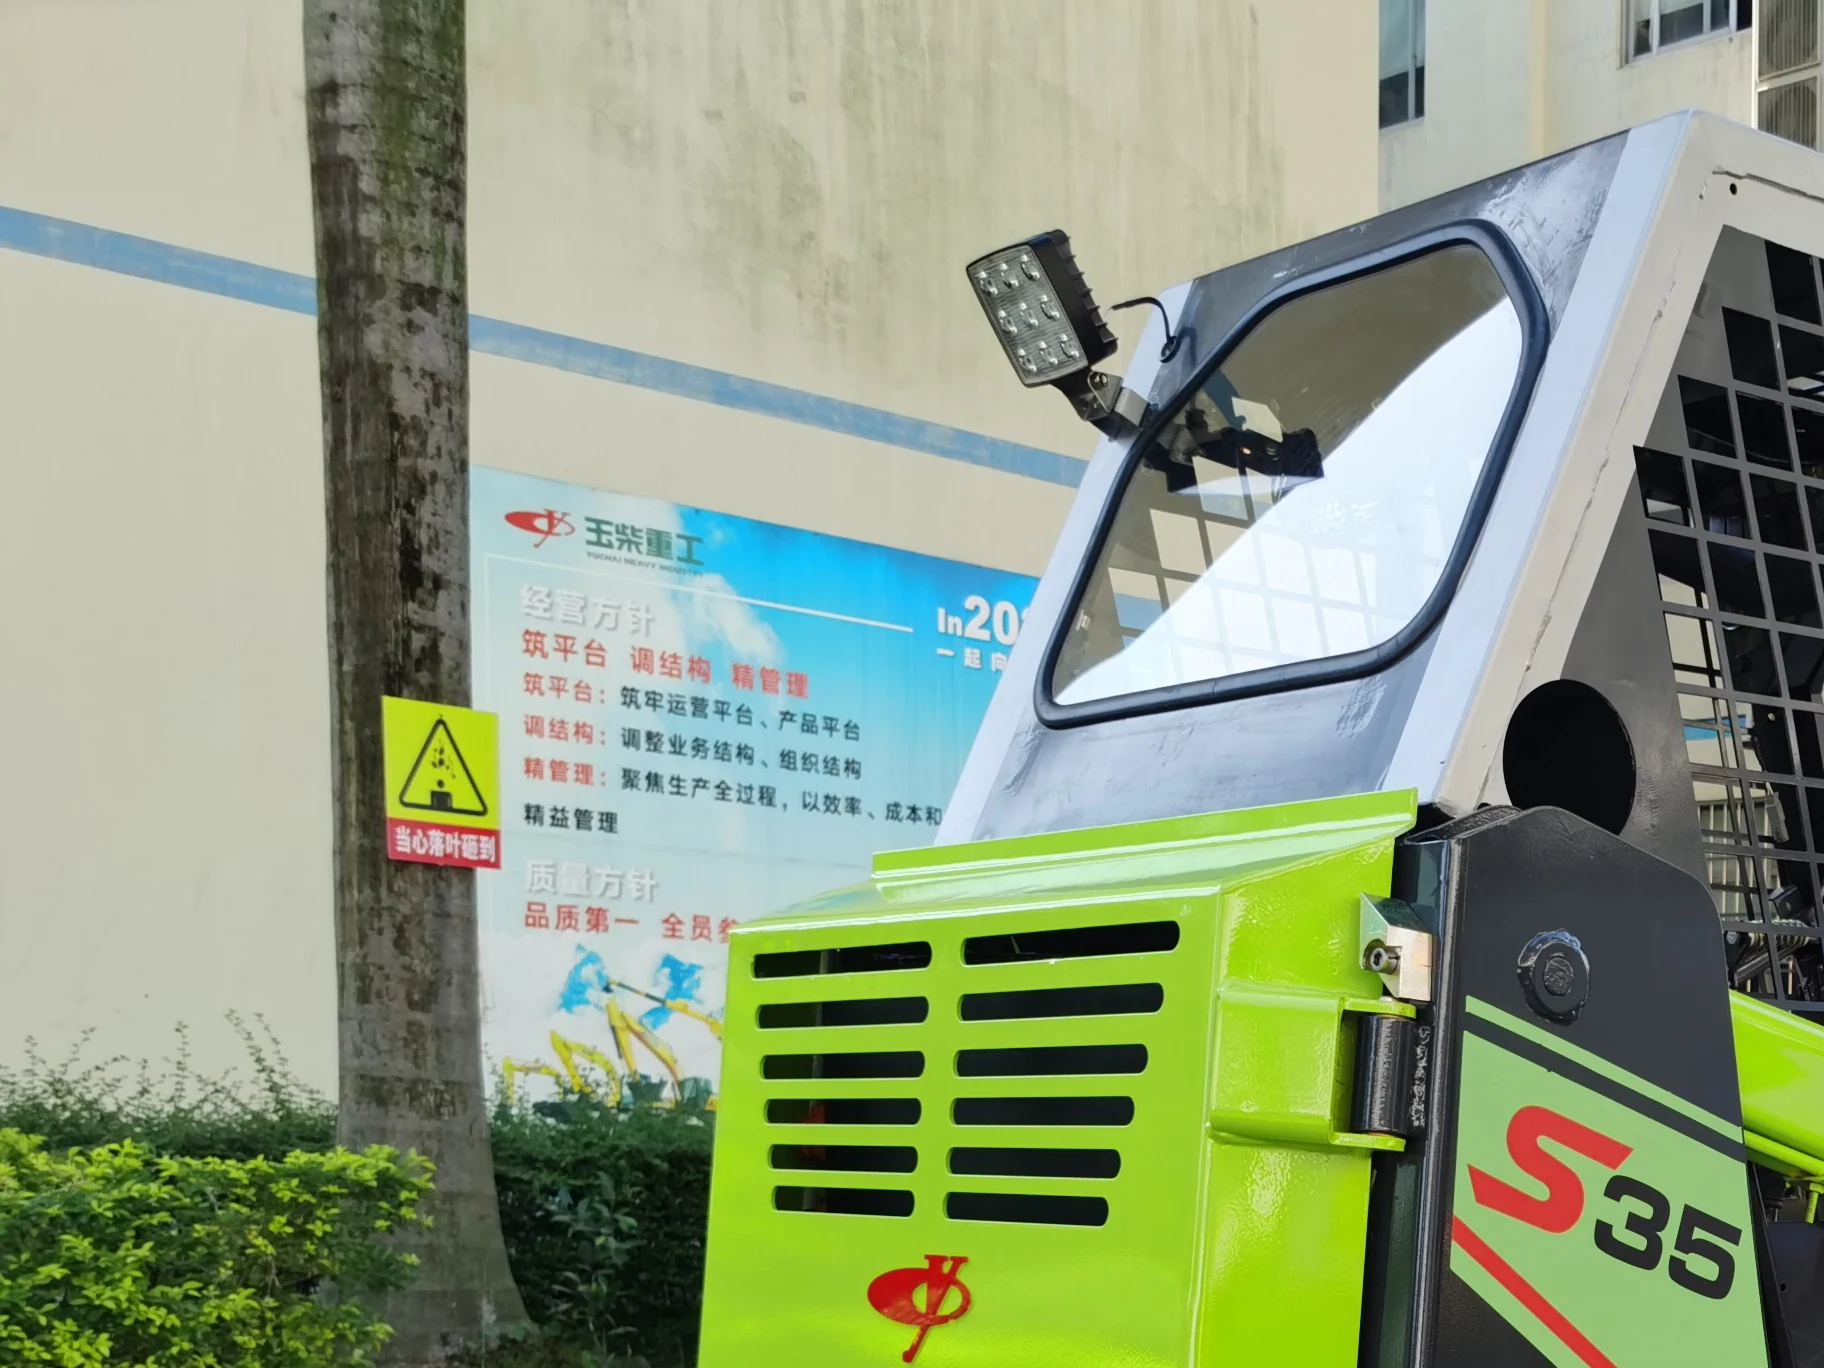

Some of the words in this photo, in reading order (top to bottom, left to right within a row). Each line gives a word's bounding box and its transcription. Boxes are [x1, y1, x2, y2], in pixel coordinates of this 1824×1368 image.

[584, 516, 704, 566] 玉柴重工
[521, 584, 655, 638] 经营方针
[522, 628, 607, 669] 筑平台
[630, 645, 712, 684] 调结构
[732, 662, 808, 699] 精管理
[523, 802, 619, 835] 精益管理
[395, 825, 497, 863] 当心落叶砸到
[526, 859, 658, 904] 质量方针
[524, 900, 640, 935] 品质第一
[1467, 1105, 1743, 1300] S35
